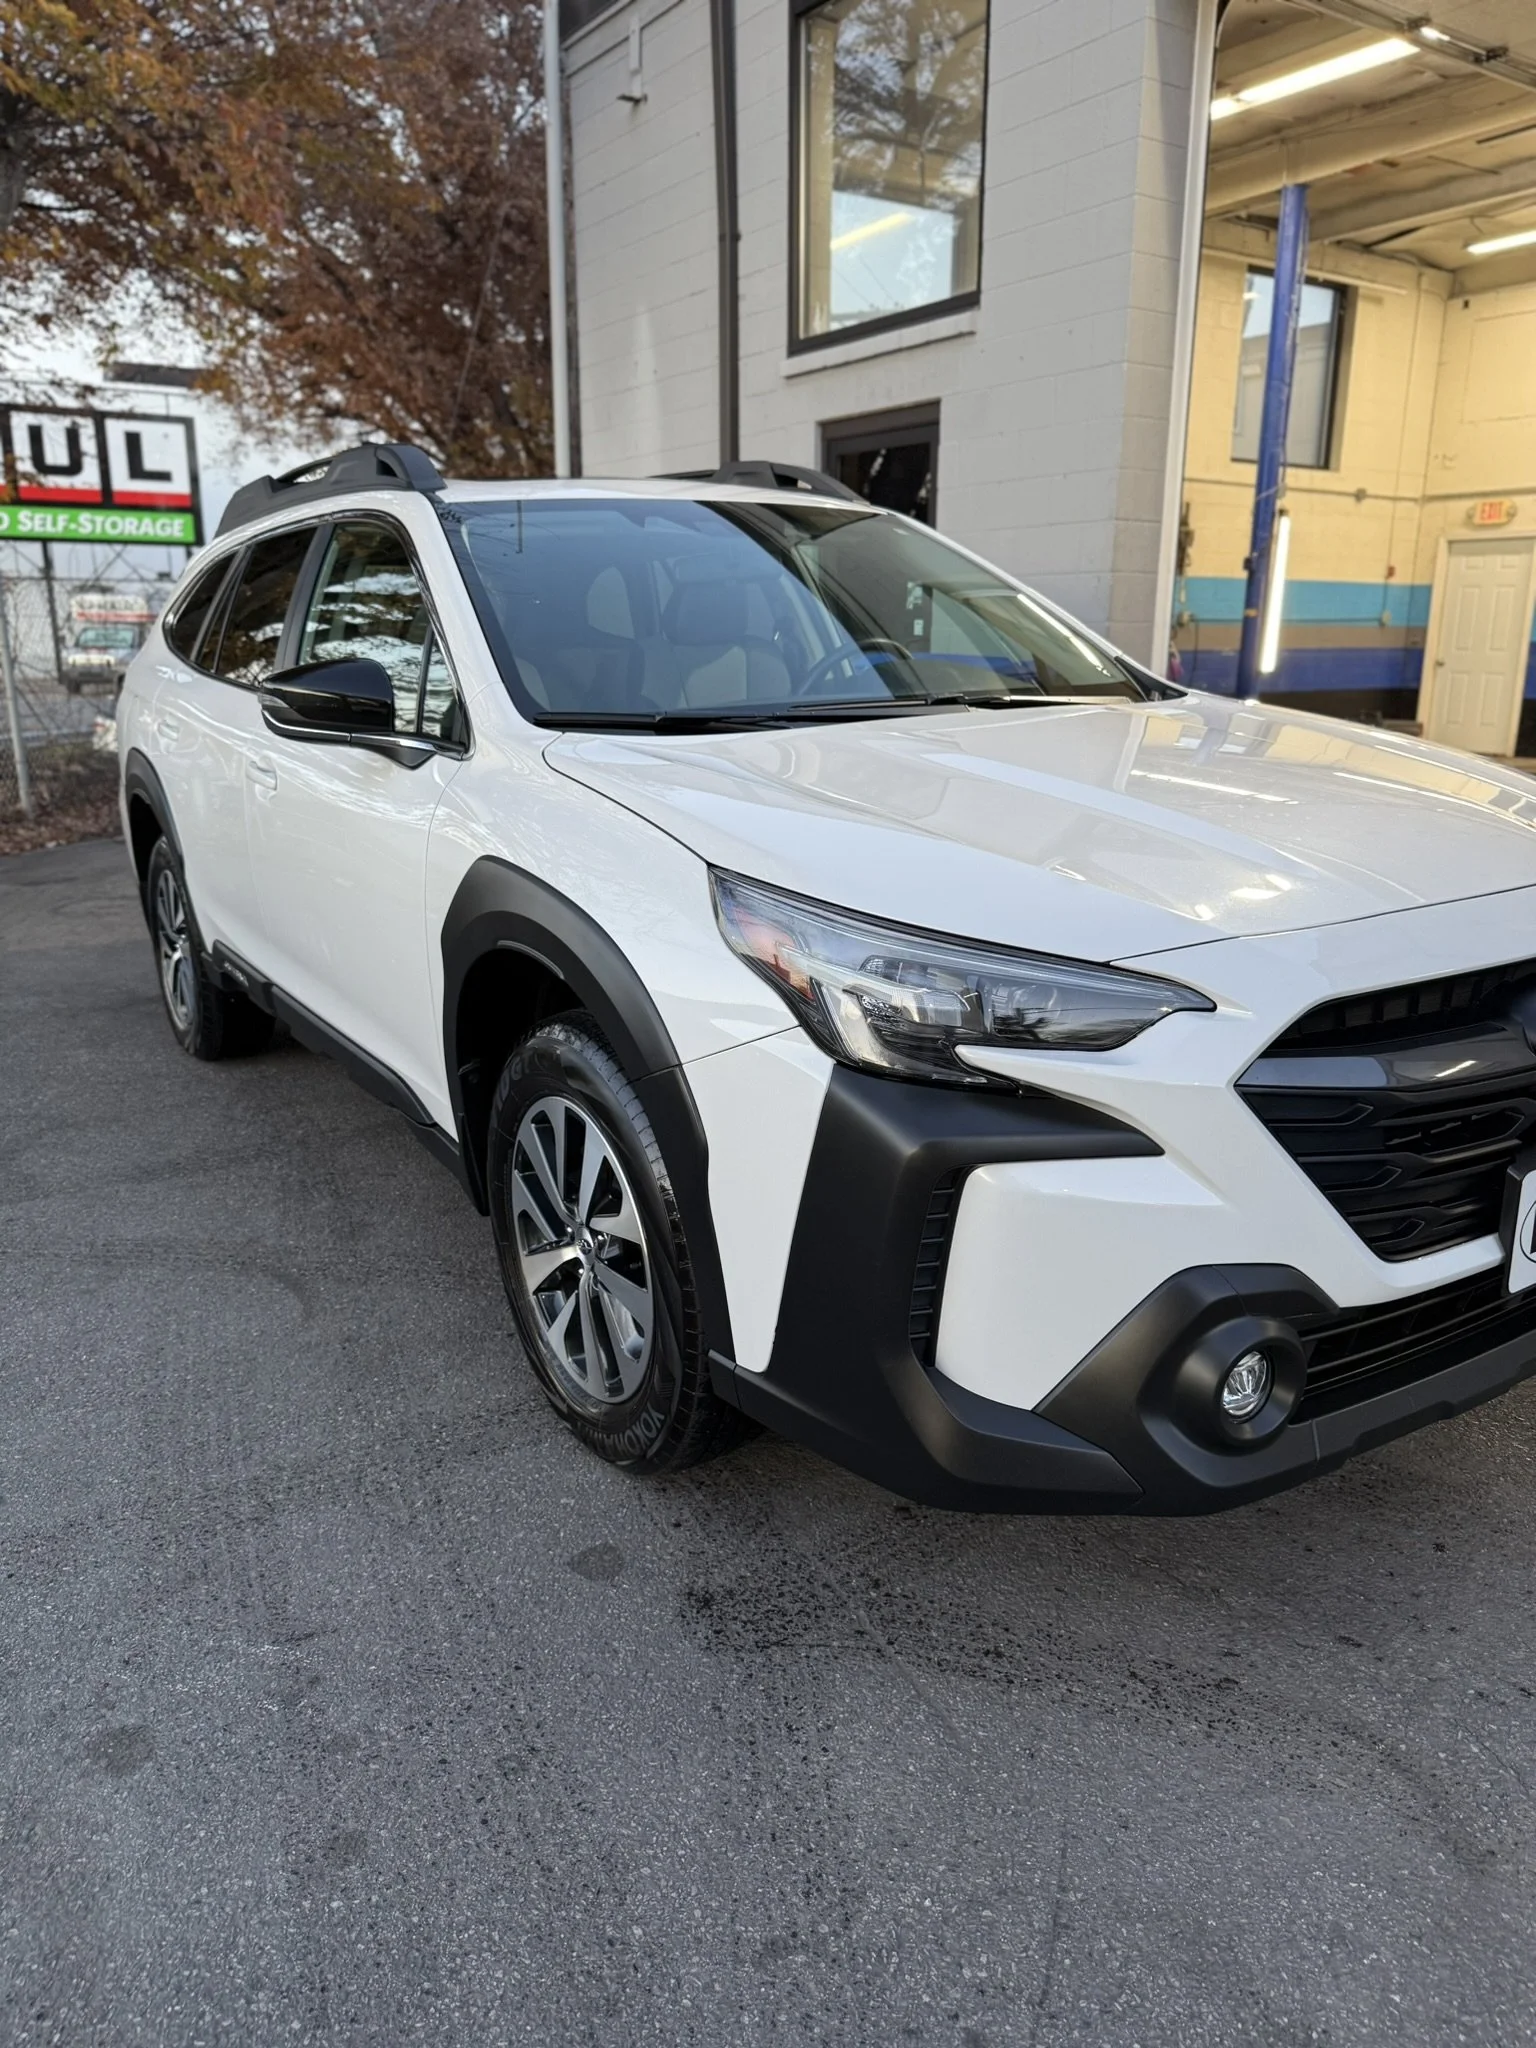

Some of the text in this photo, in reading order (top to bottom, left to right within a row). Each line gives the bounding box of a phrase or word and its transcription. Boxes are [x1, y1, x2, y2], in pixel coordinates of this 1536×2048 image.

[17, 510, 184, 537] SELF-STORAGE
[1479, 501, 1503, 521] EXIT
[577, 1401, 666, 1458] YOKOHA
